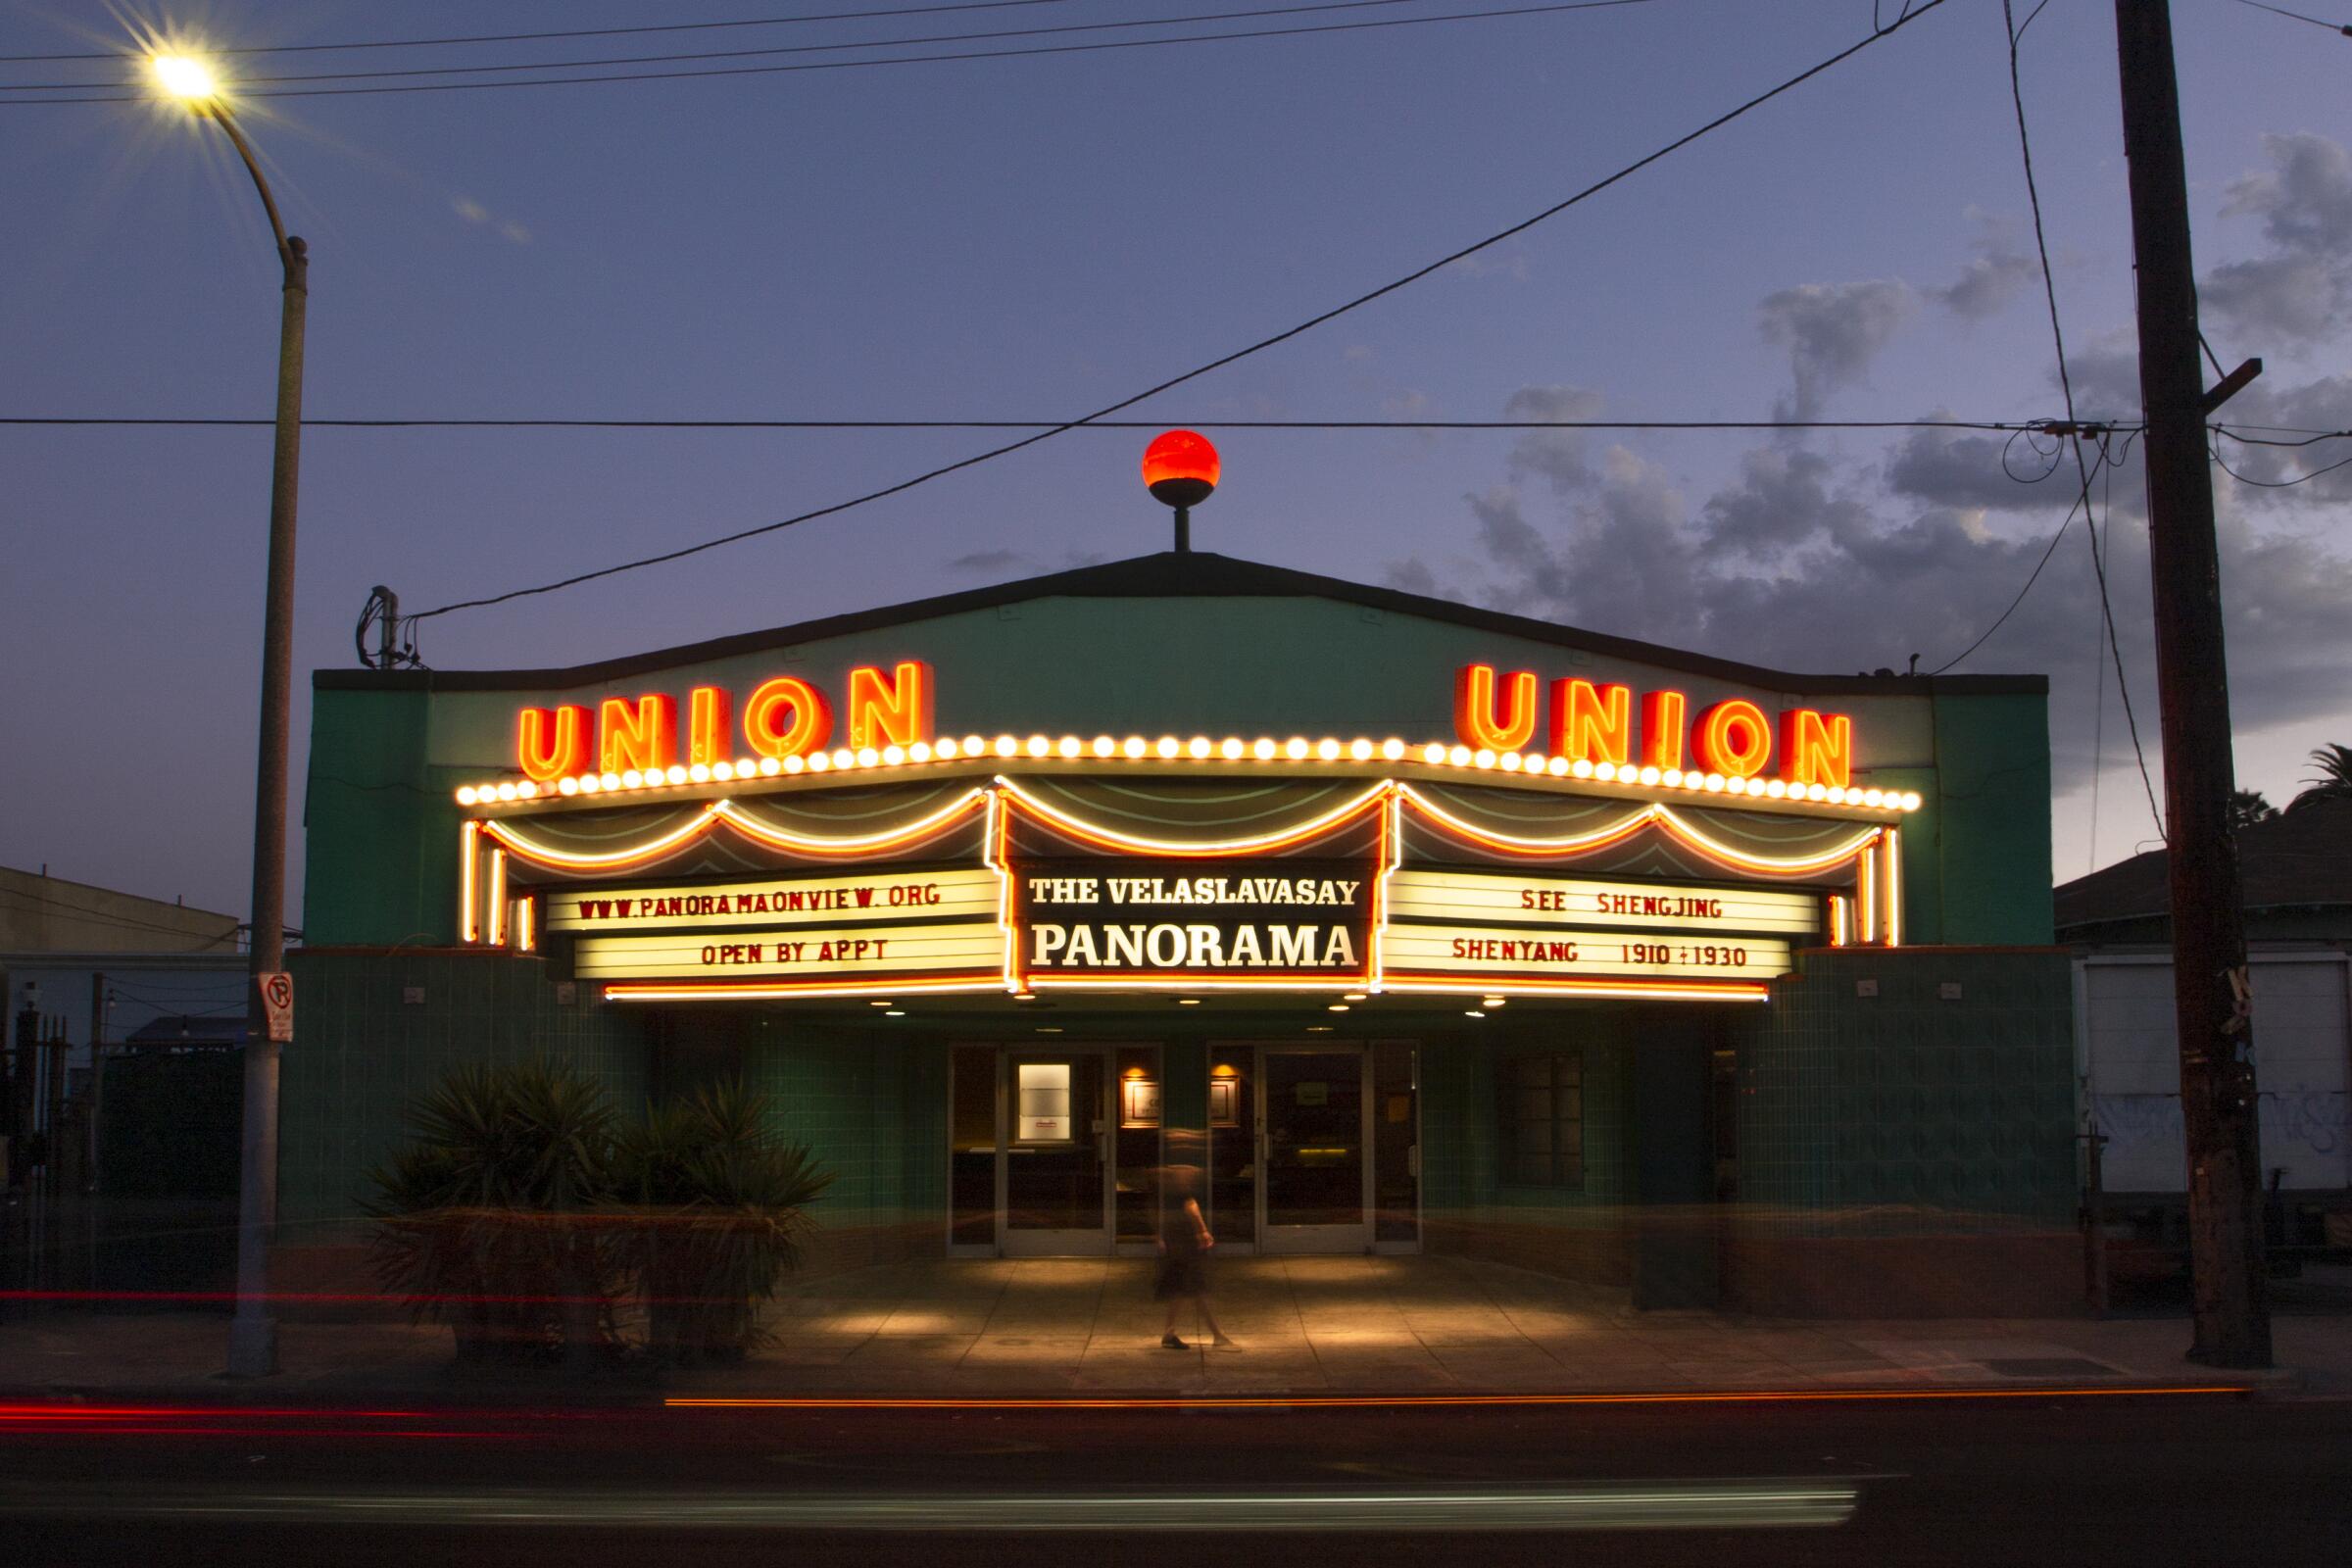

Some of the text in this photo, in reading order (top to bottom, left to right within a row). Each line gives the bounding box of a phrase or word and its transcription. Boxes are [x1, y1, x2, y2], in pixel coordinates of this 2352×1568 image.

[517, 662, 927, 782] UNION
[1456, 663, 1851, 788] UNION
[1029, 877, 1361, 906] THE VELASLAVASAY
[1520, 889, 1723, 919] SEE SHENGJING
[701, 938, 889, 965] OPEN BY APPT
[1030, 923, 1360, 968] PANORAMA
[1451, 937, 1579, 962] SHENYANG
